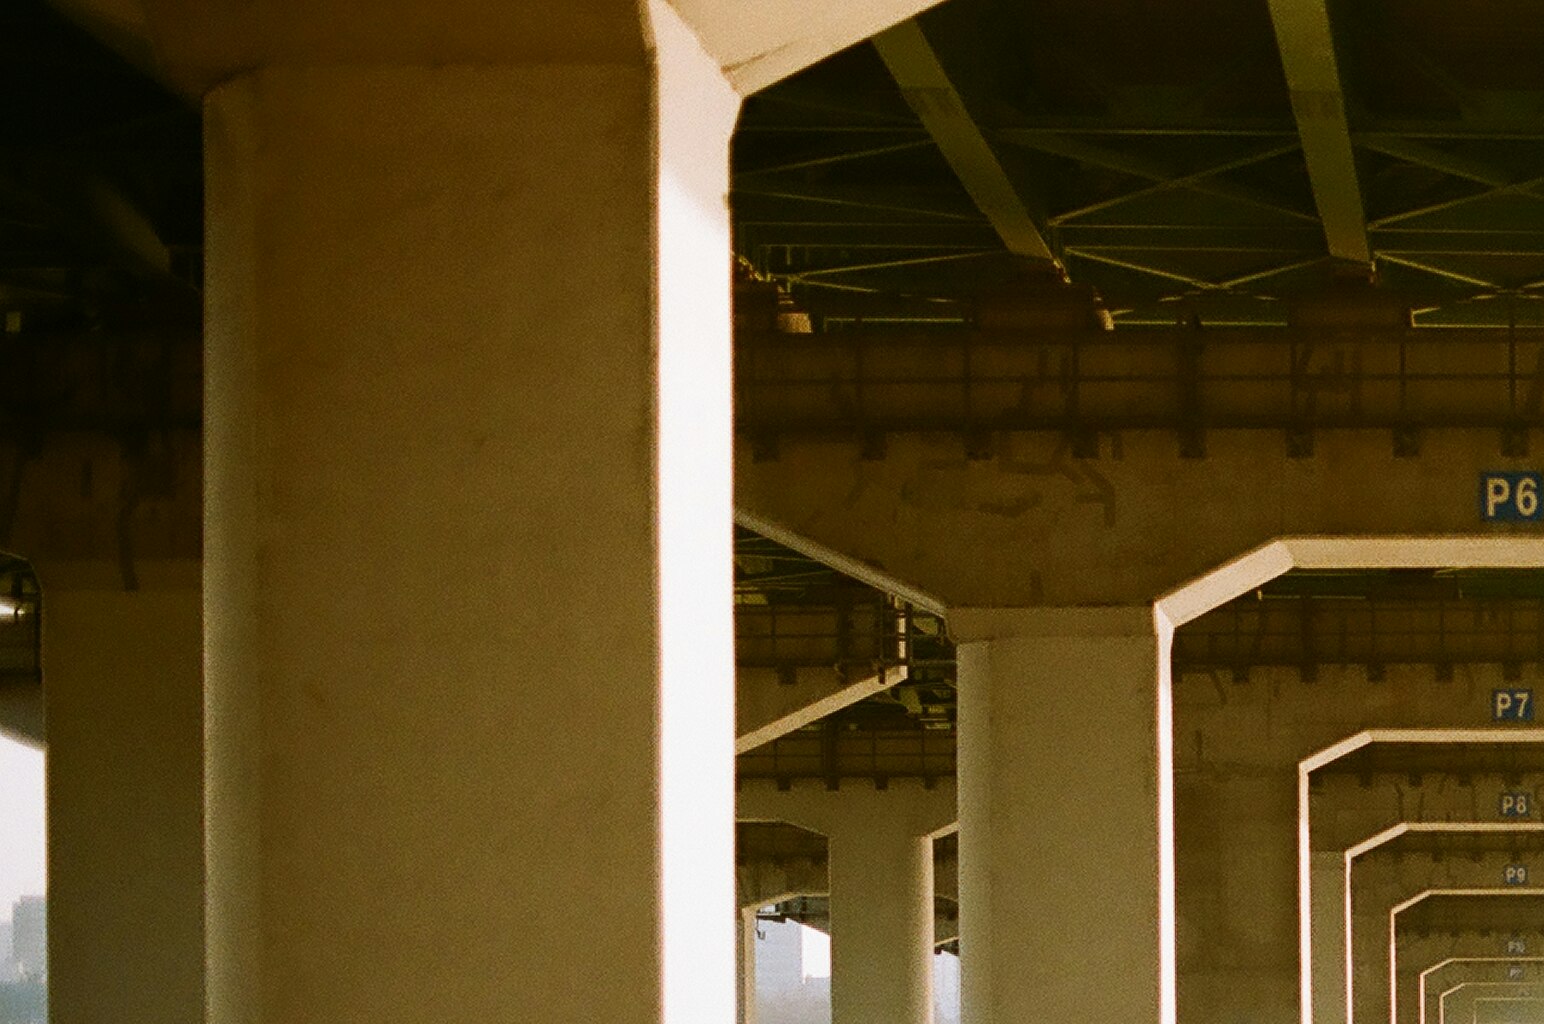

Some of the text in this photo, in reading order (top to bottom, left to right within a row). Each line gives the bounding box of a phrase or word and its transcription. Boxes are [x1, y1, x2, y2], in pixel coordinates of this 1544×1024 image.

[1487, 477, 1538, 517] P6
[1496, 692, 1529, 718] P7
[1502, 795, 1527, 814] P8
[1505, 867, 1526, 883] P9
